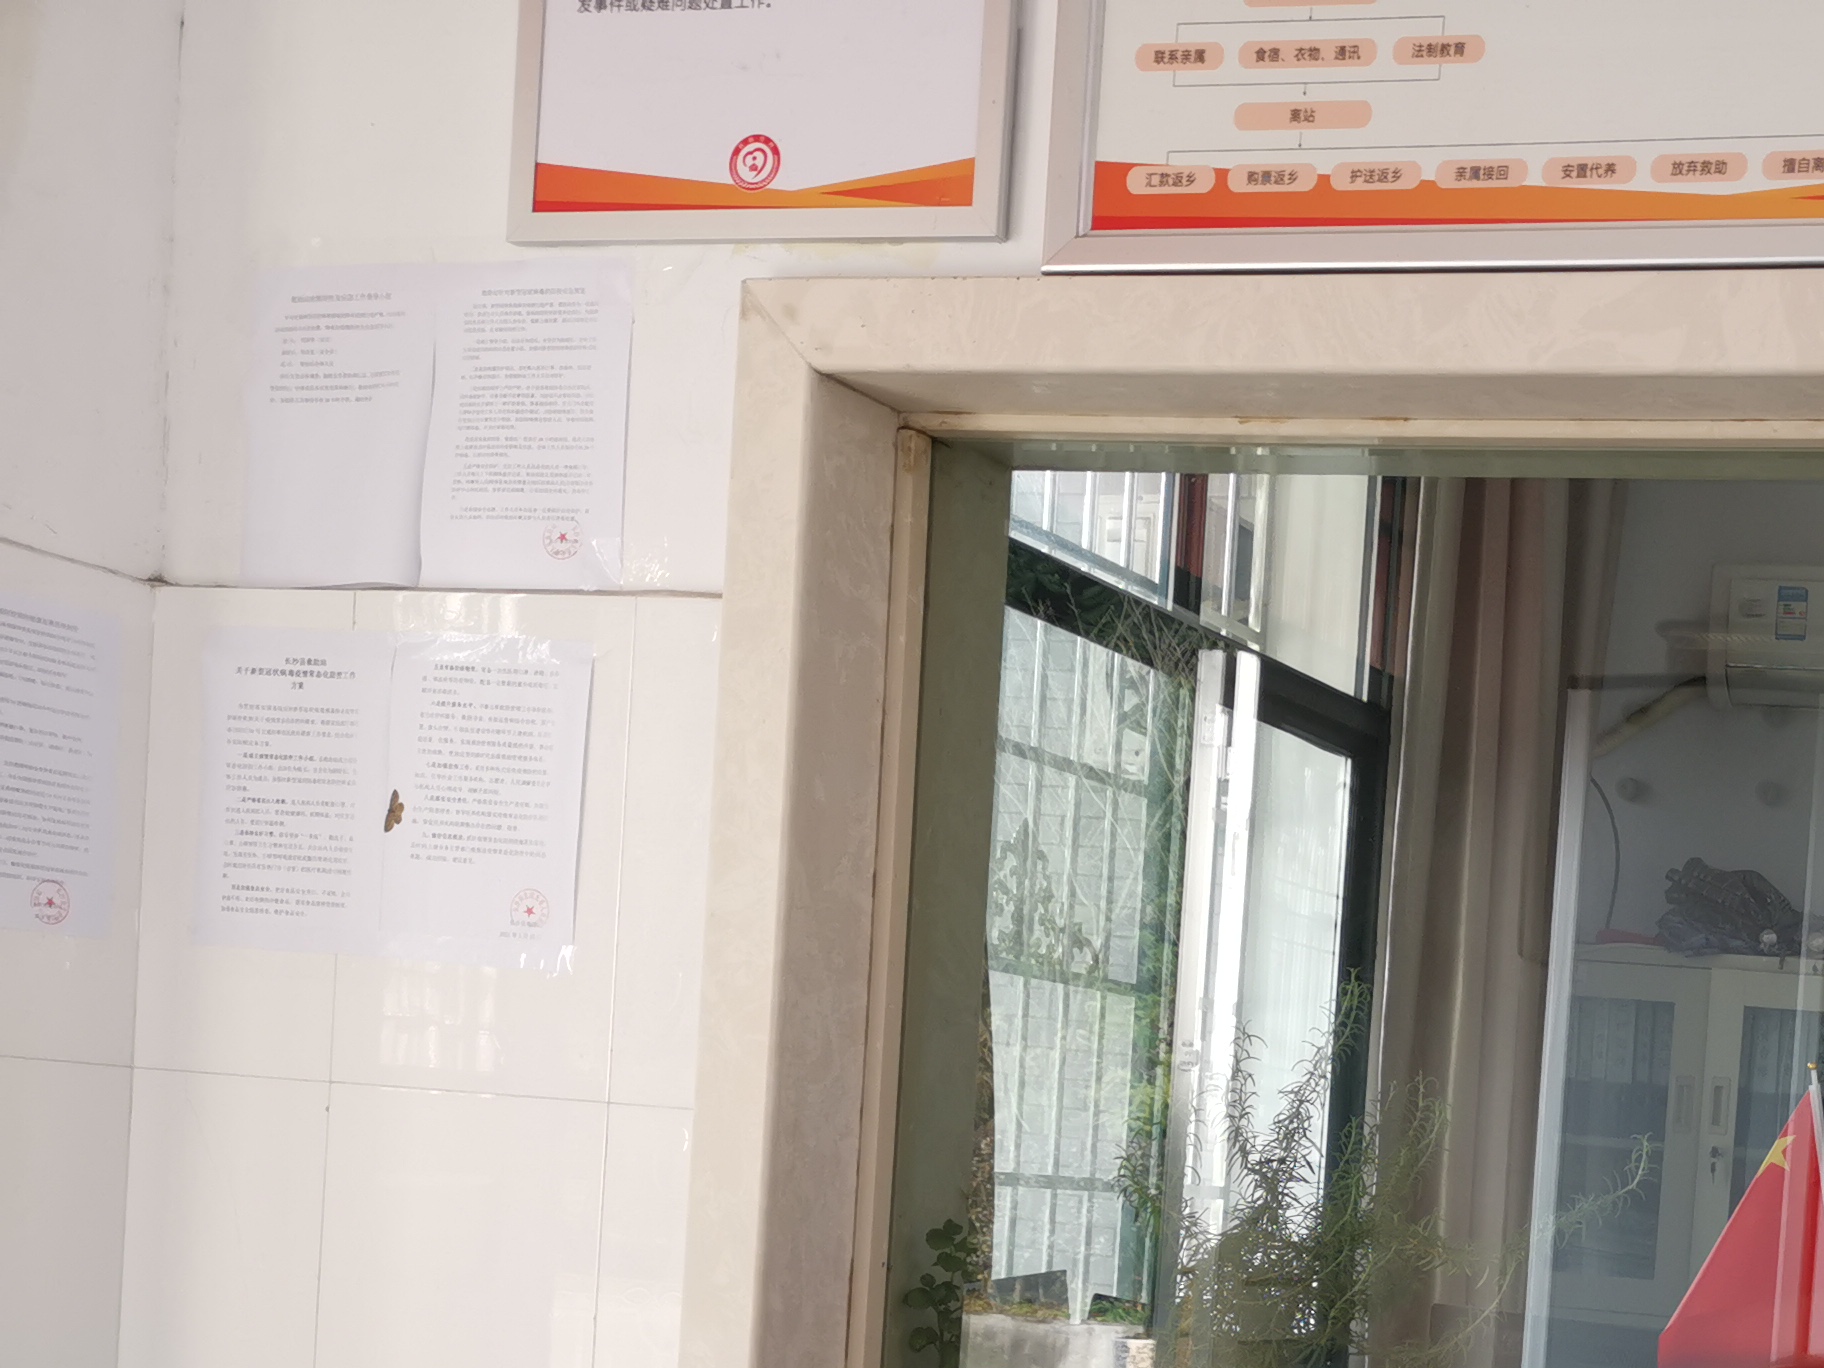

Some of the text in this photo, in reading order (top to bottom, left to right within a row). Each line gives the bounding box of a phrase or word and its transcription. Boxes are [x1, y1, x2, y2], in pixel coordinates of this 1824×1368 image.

[1153, 48, 1206, 65] 联系亲属
[1411, 42, 1466, 58] 法制教育
[1289, 108, 1316, 124] 离站
[1348, 167, 1403, 184] 护送返乡
[1454, 165, 1509, 182] 亲属接回
[1560, 162, 1617, 180] 安置代养
[1670, 158, 1728, 176] 放弃救助
[1144, 171, 1197, 189] 汇款返乡
[1246, 169, 1299, 186] 购票返乡
